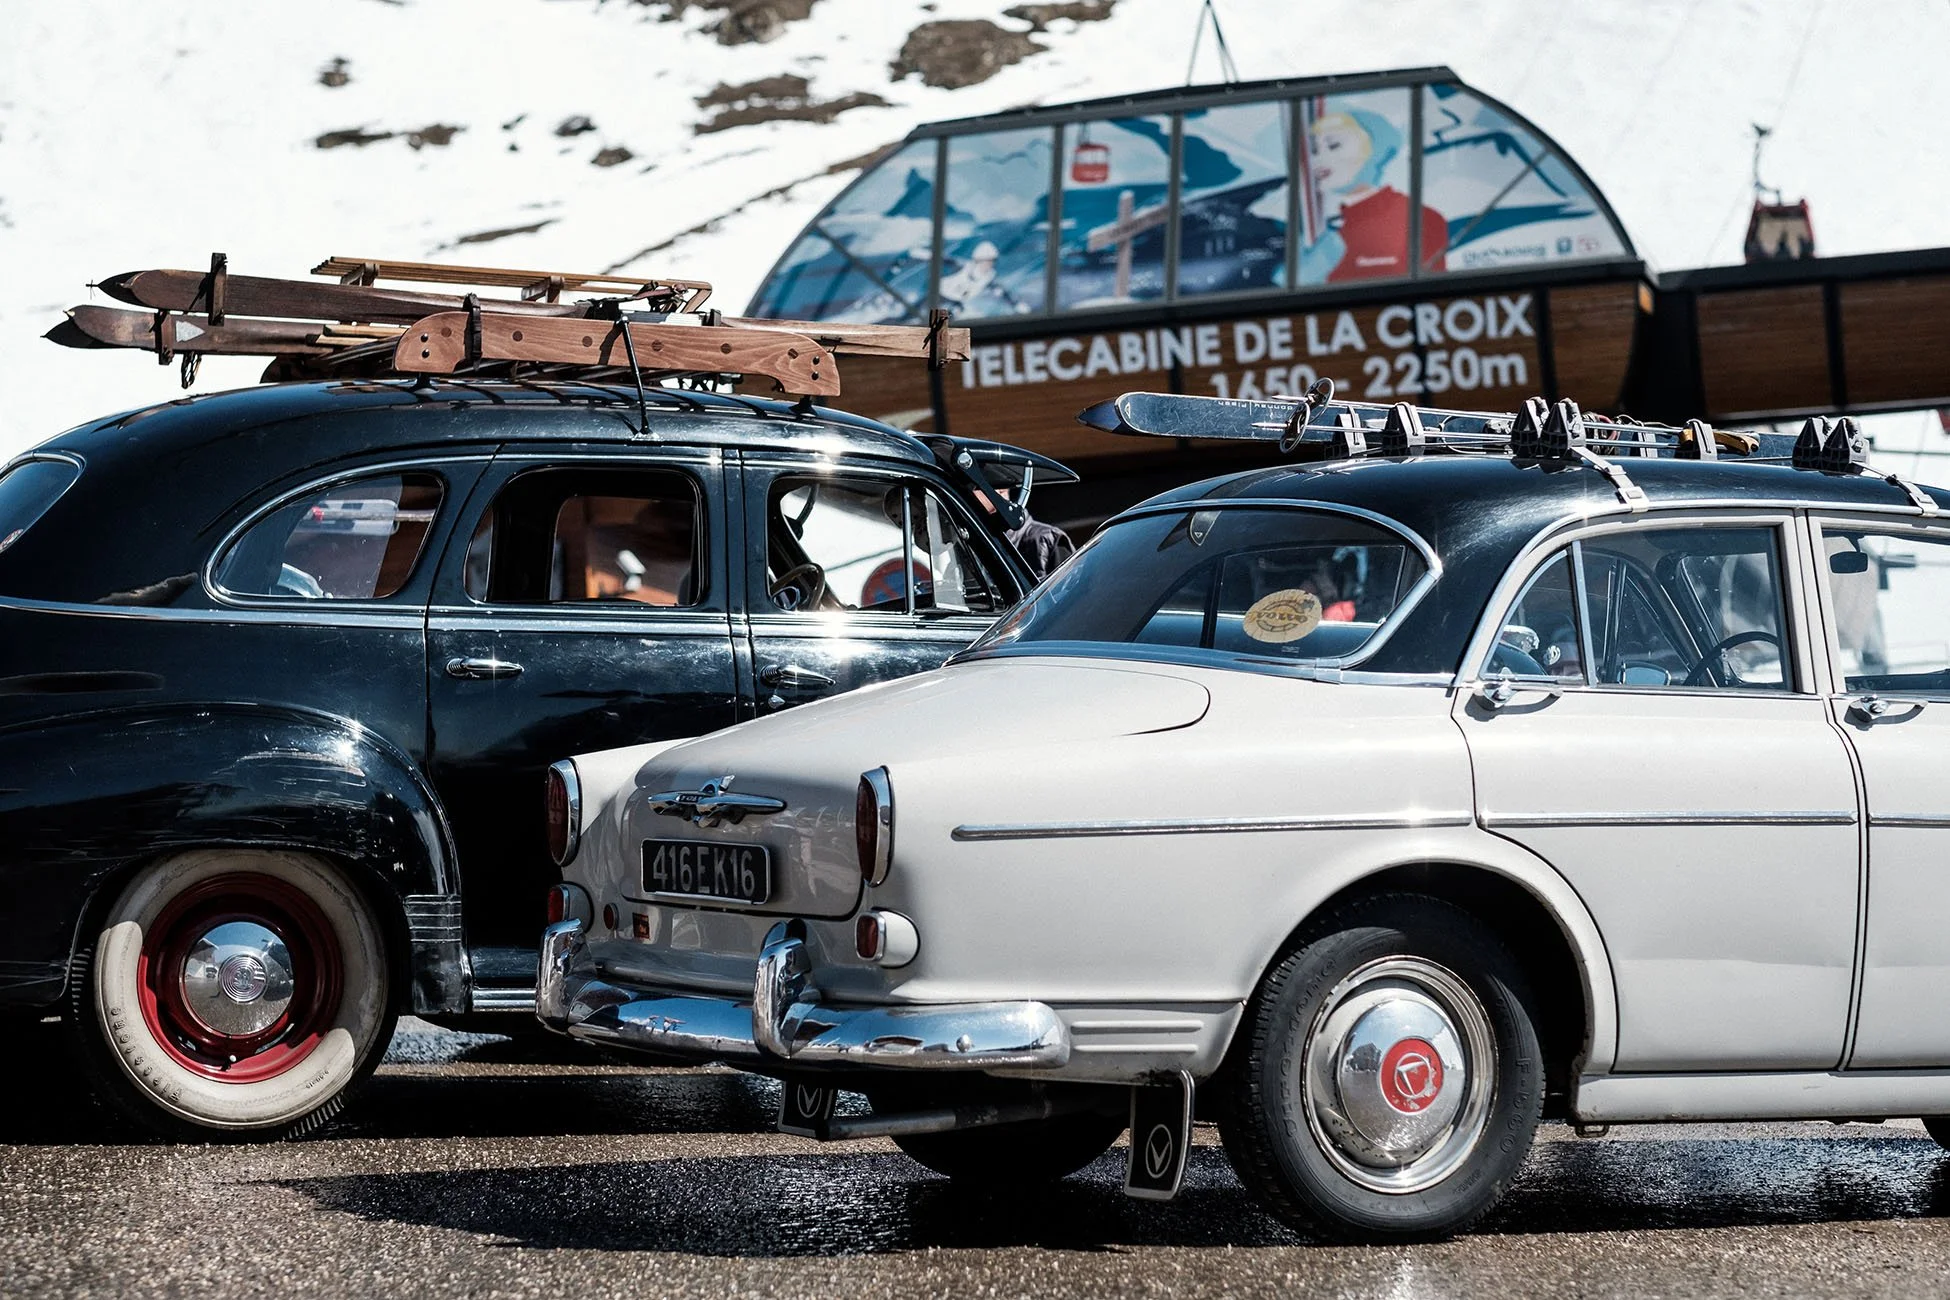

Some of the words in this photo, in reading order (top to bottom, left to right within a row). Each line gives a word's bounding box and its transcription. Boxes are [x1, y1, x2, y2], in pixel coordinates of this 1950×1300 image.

[961, 324, 1222, 389] TELECABINE
[1233, 317, 1294, 364] DE
[1305, 310, 1367, 356] LA
[1376, 294, 1535, 347] CROIX
[1363, 347, 1528, 398] 2250m
[653, 845, 755, 897] 416EK16
